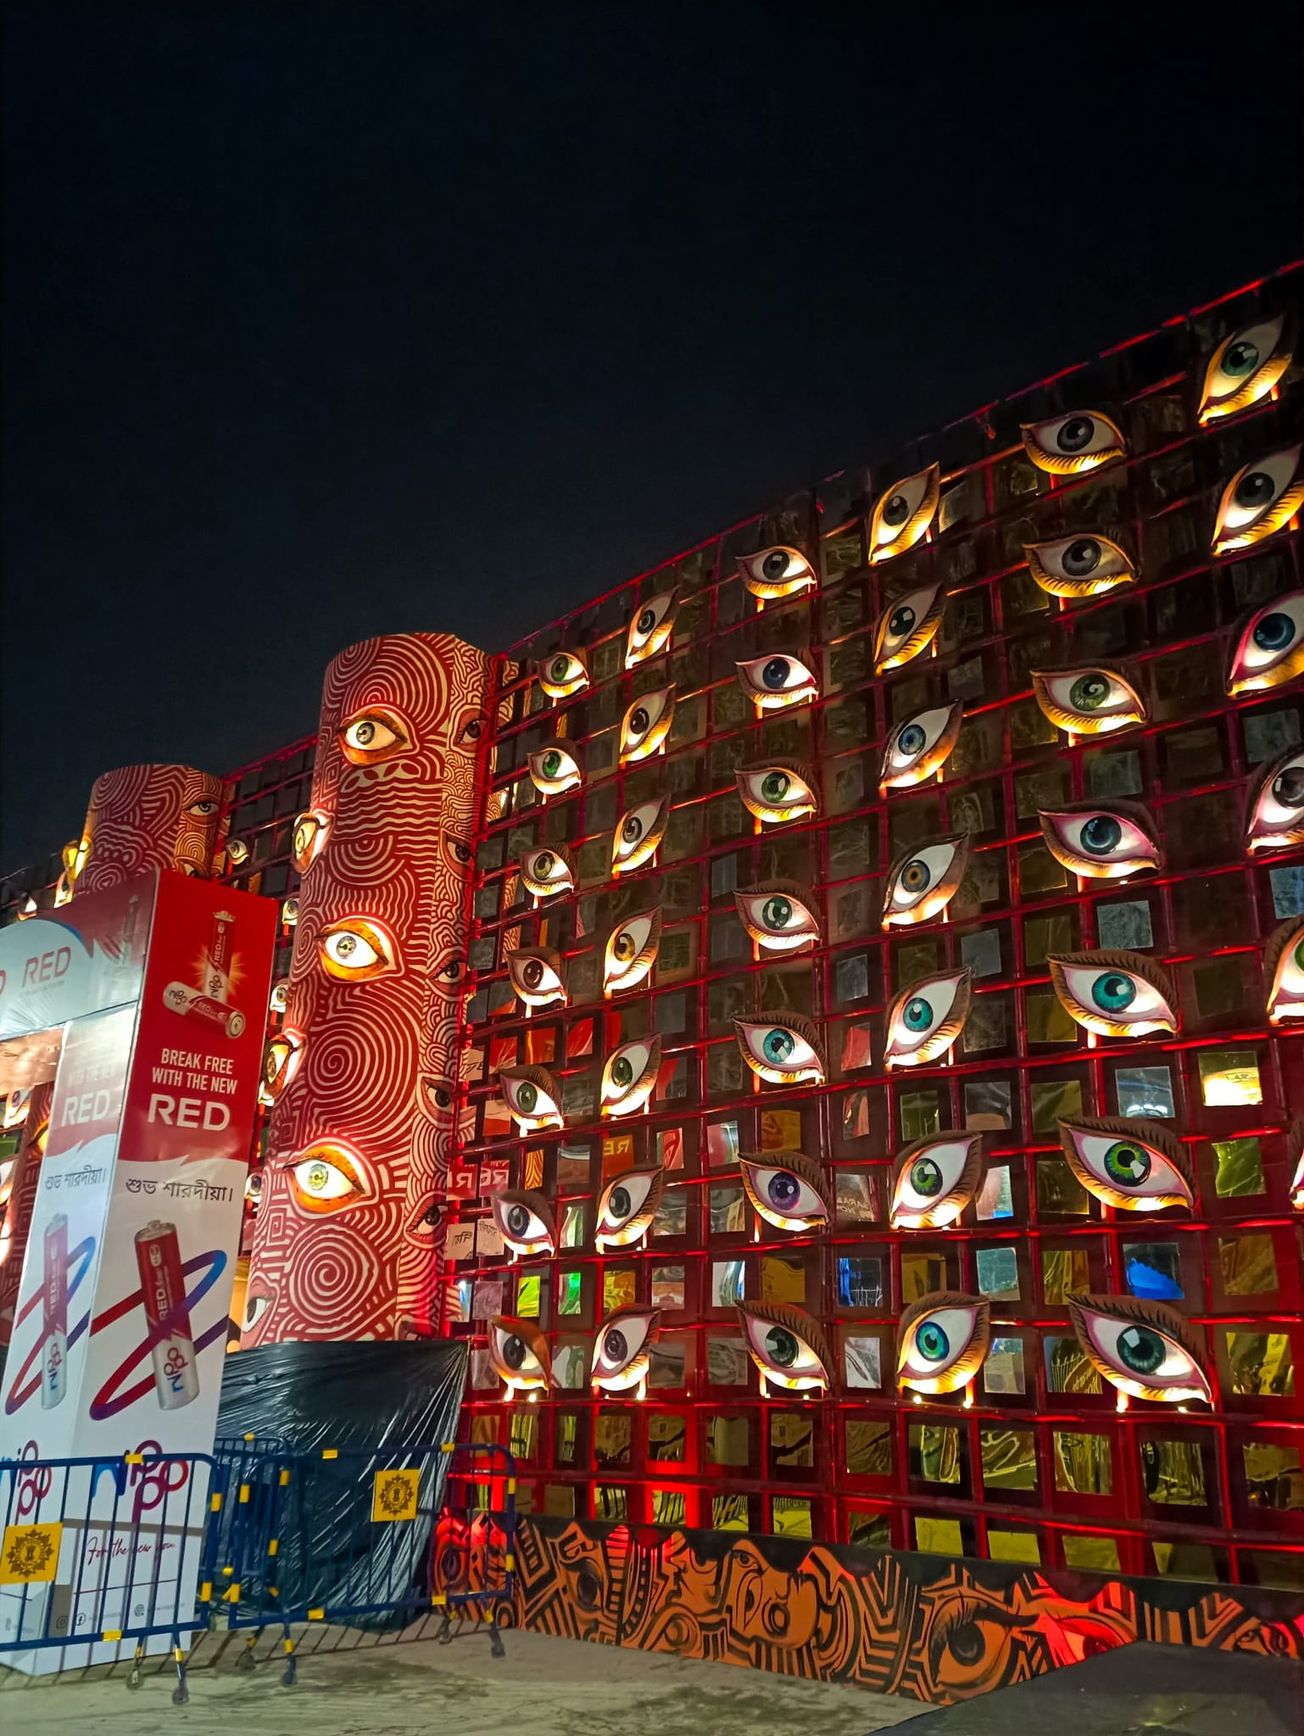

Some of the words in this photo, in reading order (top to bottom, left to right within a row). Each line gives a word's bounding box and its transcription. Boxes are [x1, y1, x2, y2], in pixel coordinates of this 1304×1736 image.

[22, 946, 72, 988] RED
[161, 1048, 202, 1070] BREAK
[204, 1055, 234, 1075] FREE
[152, 1067, 183, 1087] WITH
[186, 1072, 209, 1091] THE
[210, 1076, 238, 1095] NEW
[61, 1090, 111, 1127] RED
[147, 1093, 231, 1132] RED
[125, 1177, 158, 1195] শুভ
